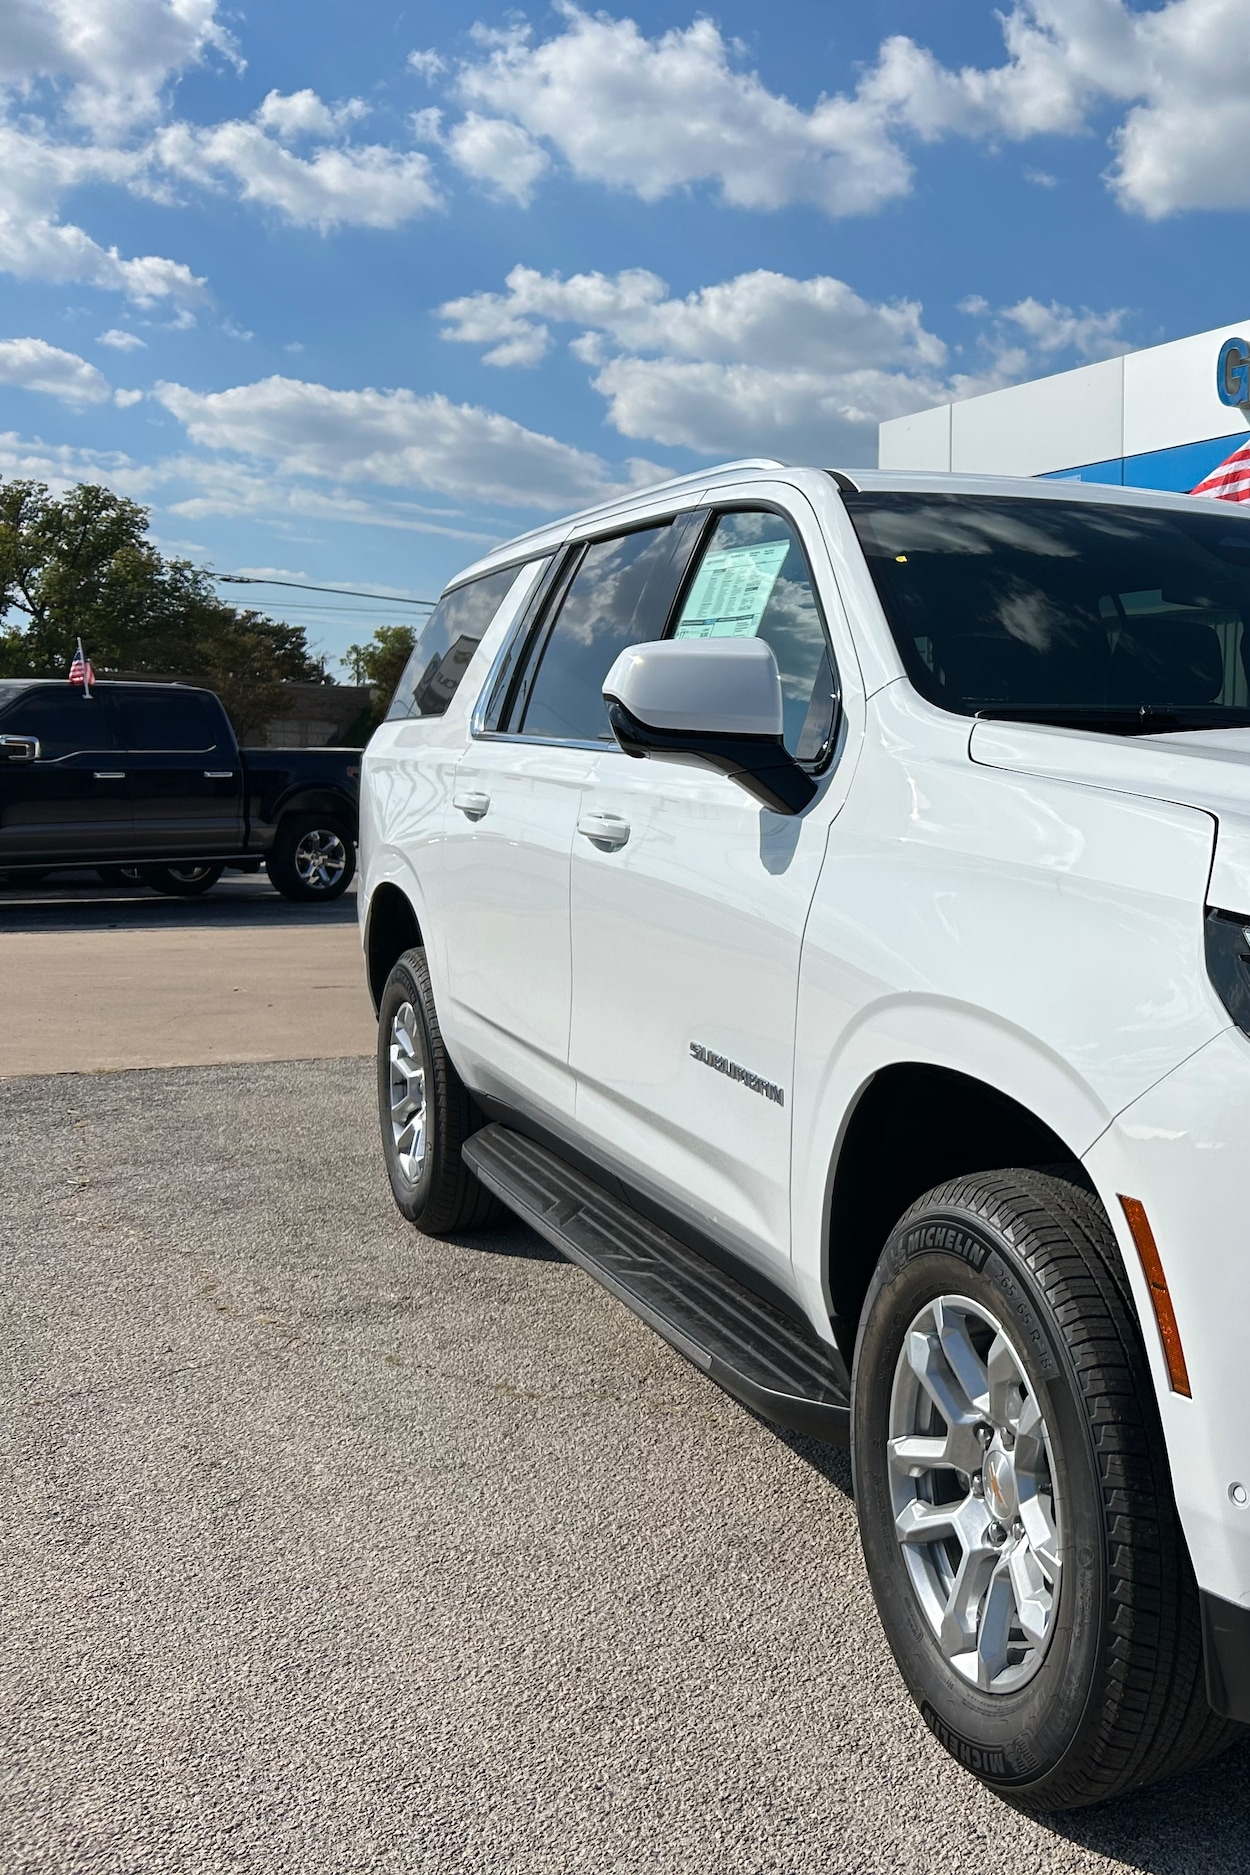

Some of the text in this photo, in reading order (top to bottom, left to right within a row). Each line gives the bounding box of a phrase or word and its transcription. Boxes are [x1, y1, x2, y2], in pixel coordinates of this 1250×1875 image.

[689, 1041, 784, 1107] SUBURBAN
[908, 1227, 986, 1266] MICHELIN
[994, 1269, 1033, 1325] 265/65
[924, 1706, 1005, 1774] MICHELIN
